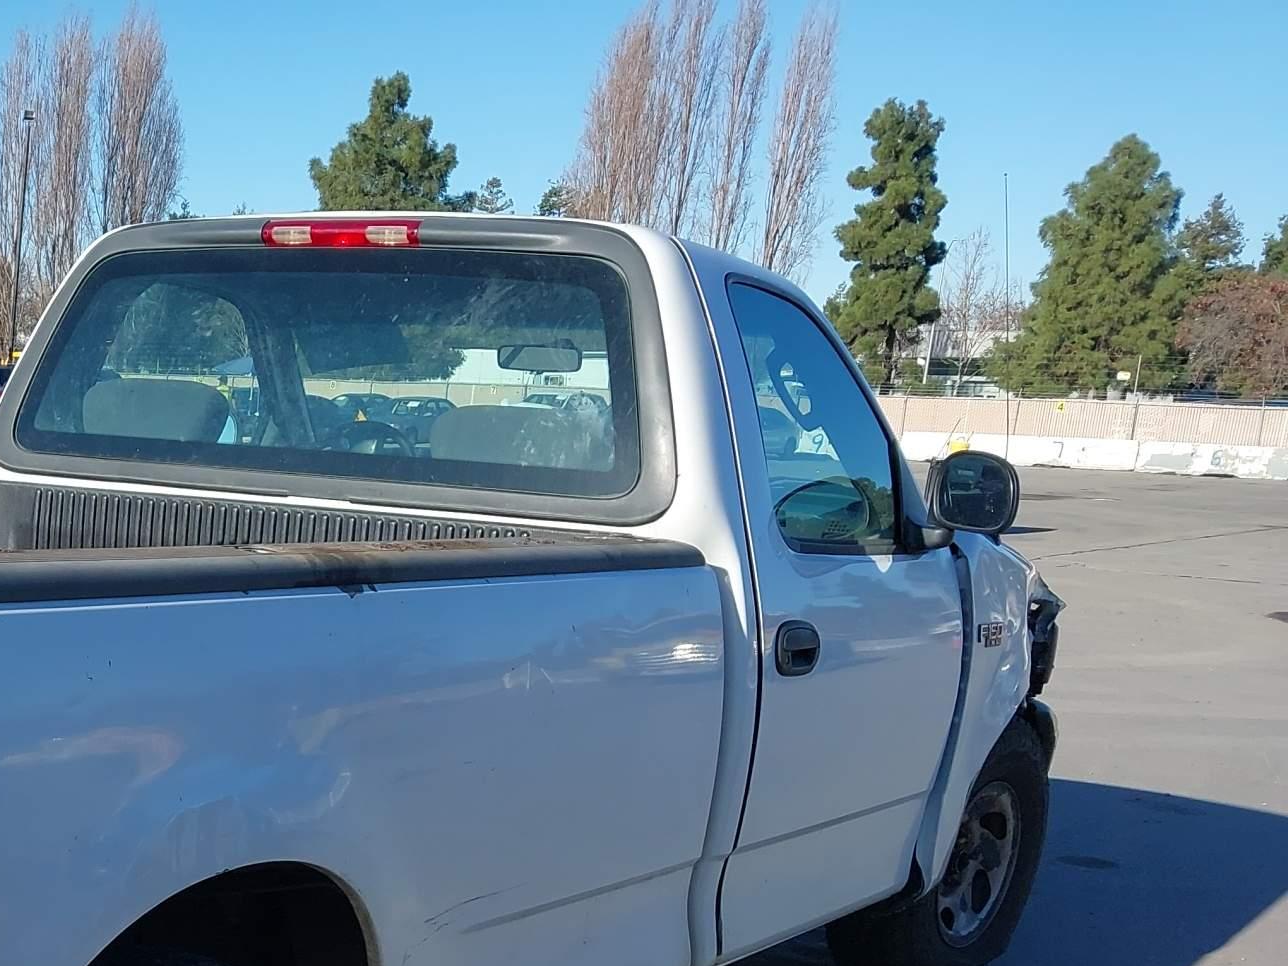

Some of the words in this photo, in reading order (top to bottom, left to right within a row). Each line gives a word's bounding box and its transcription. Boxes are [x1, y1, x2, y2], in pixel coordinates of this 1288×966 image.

[812, 433, 824, 453] 9
[1053, 441, 1064, 458] 7
[1211, 450, 1224, 466] 6
